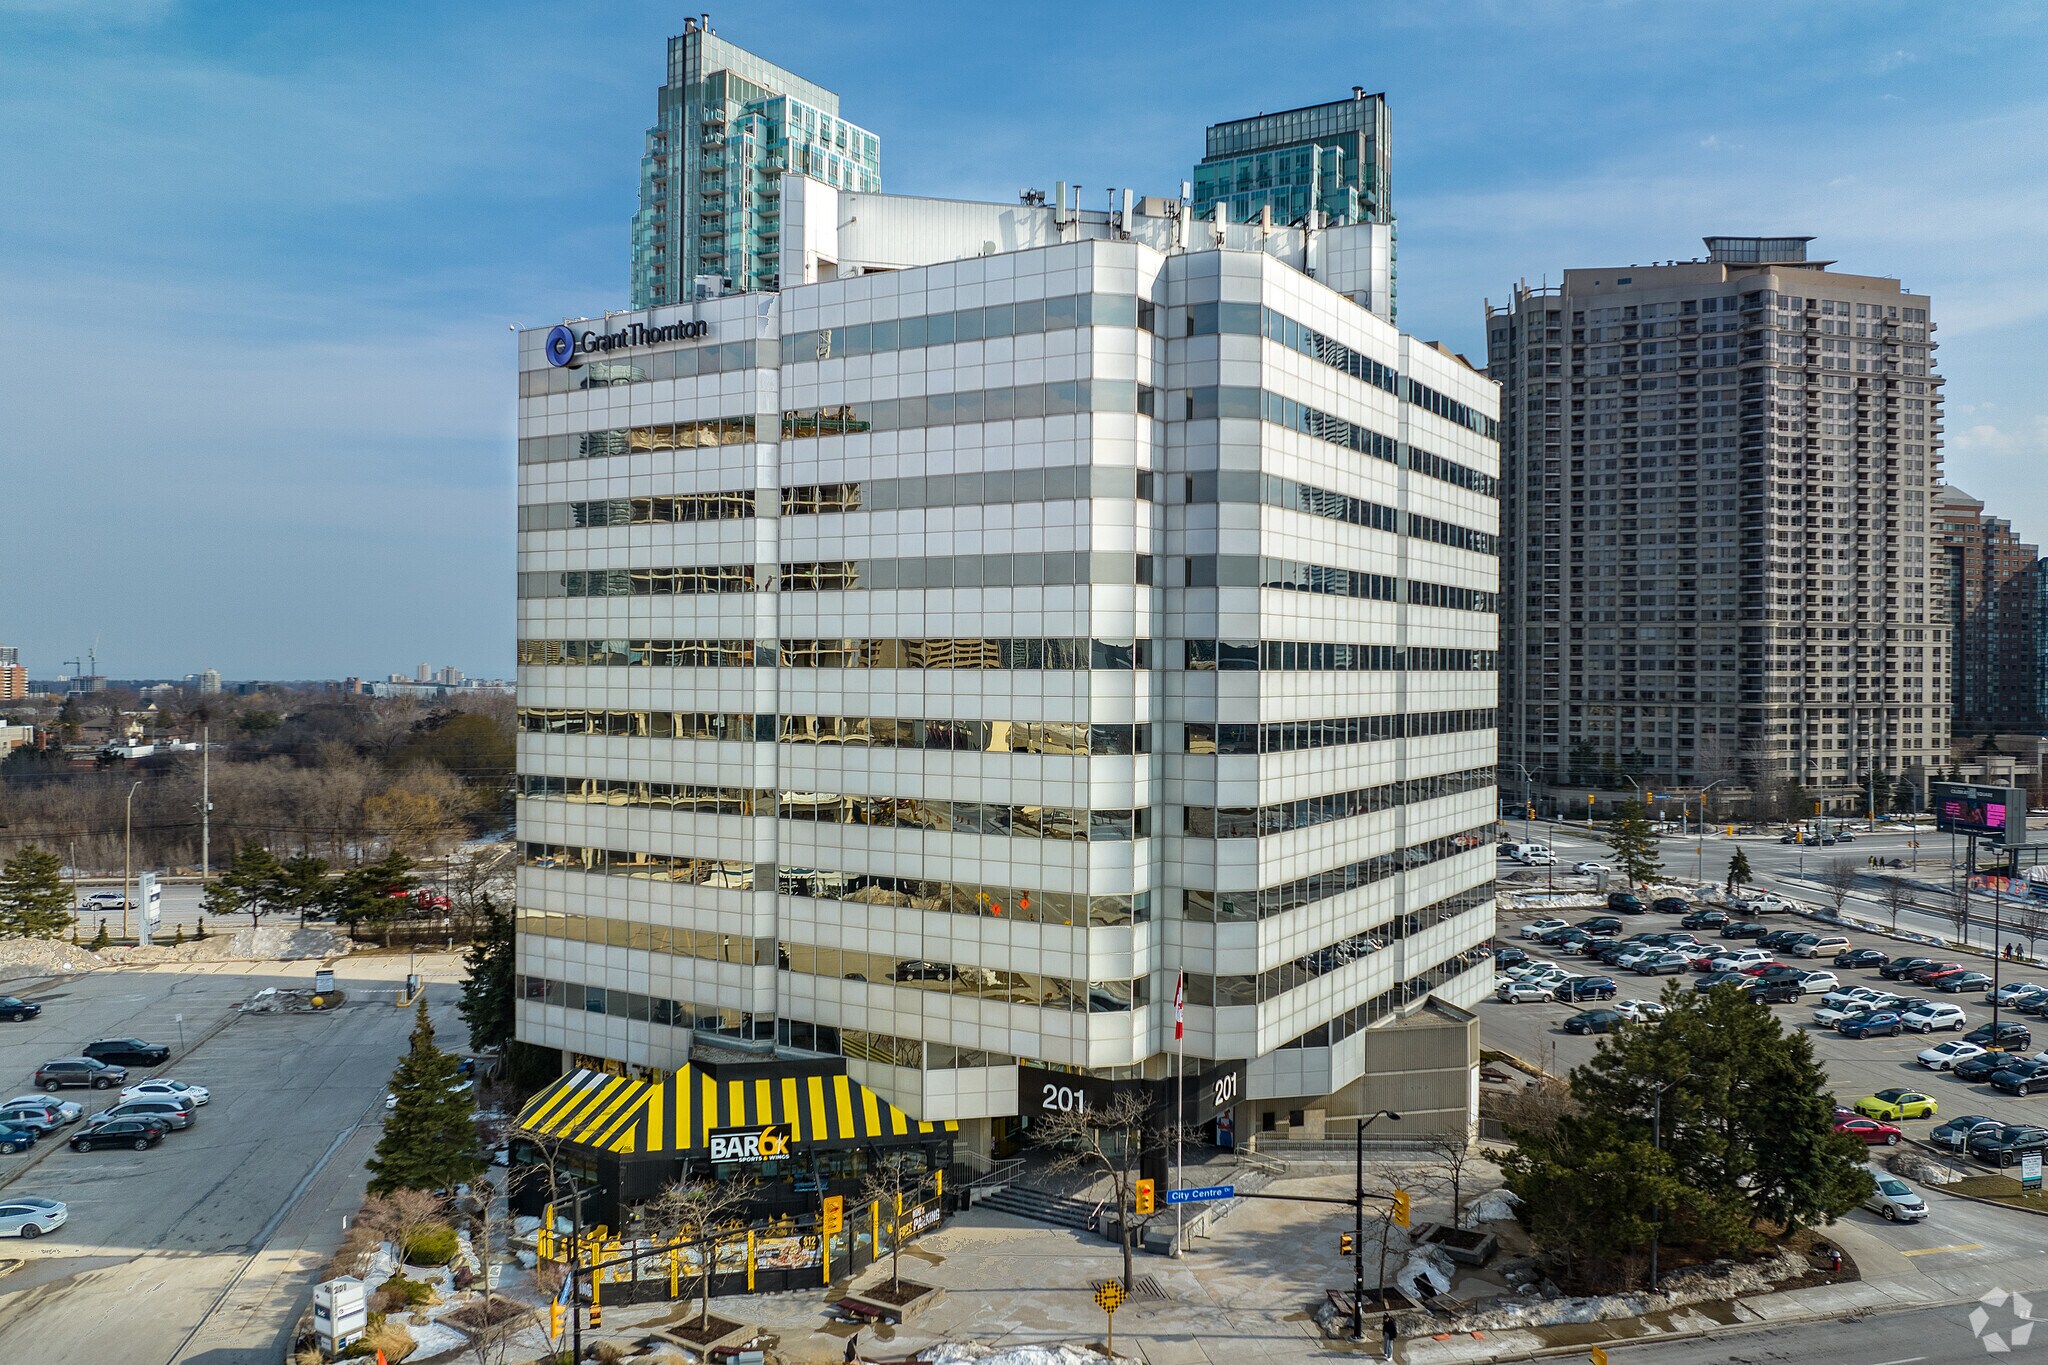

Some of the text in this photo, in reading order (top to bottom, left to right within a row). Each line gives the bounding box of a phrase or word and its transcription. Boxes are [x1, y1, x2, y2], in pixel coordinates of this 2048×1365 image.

[581, 319, 708, 353] Grant Thornton
[1043, 1084, 1084, 1114] 201
[1215, 1071, 1237, 1106] 201
[1171, 1191, 1190, 1201] City
[1192, 1190, 1222, 1198] Centre
[803, 1235, 817, 1247] $12
[334, 1283, 347, 1294] 201
